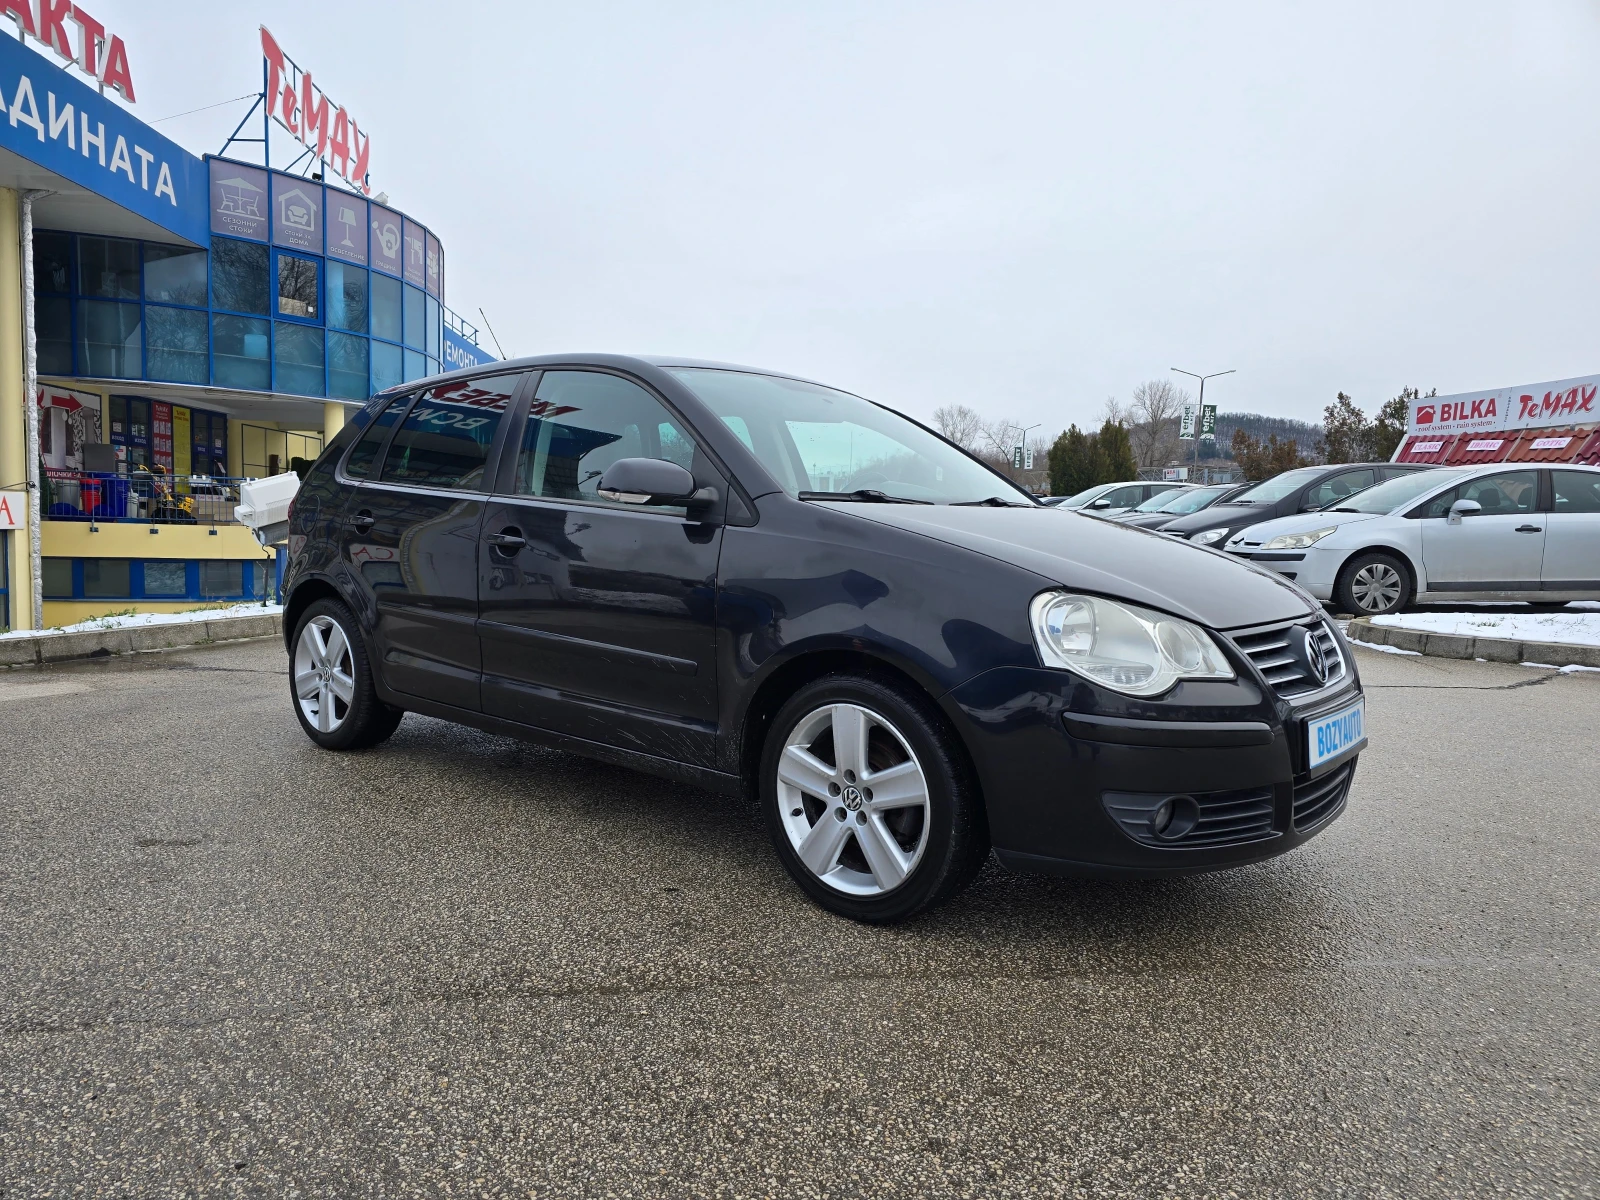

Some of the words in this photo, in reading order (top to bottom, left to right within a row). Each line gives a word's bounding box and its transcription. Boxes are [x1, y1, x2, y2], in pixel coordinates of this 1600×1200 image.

[259, 23, 371, 195] TeMAX
[0, 74, 177, 207] ДИНАТА
[222, 216, 257, 227] СЕЗОННИ
[228, 225, 253, 234] СТОКИ
[289, 237, 309, 246] ДОМА
[444, 340, 478, 369] ЕМОНТ
[1440, 398, 1497, 422] BILKA
[1518, 385, 1598, 421] TeMAX
[1183, 405, 1191, 430] efbet
[1202, 406, 1211, 431] efbet
[1417, 424, 1431, 432] roof
[1431, 424, 1452, 433] system
[1470, 420, 1493, 429] system
[1317, 709, 1361, 758] BOZYAUTO
